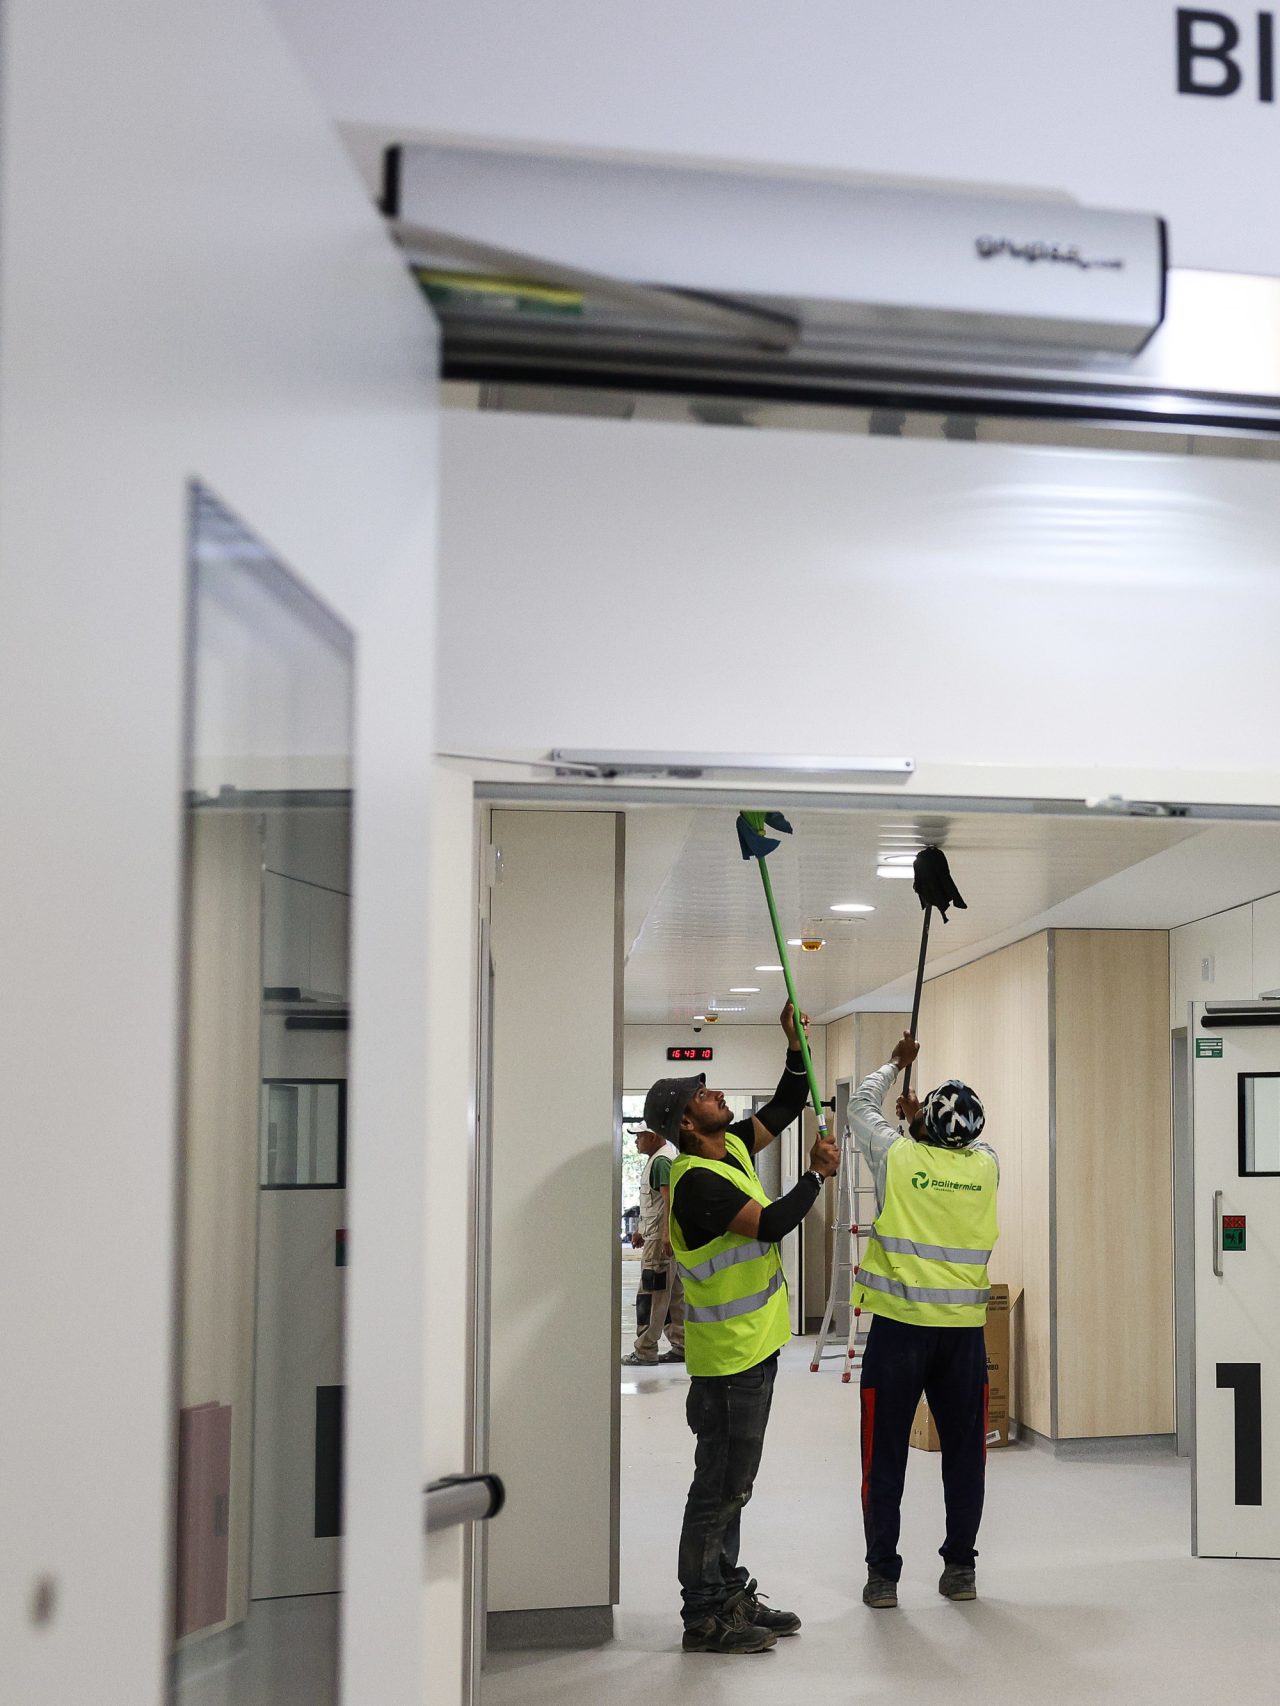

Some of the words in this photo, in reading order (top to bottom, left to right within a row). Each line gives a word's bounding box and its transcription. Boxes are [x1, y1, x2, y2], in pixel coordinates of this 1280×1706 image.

[672, 1049, 681, 1058] 16
[684, 1049, 695, 1058] 43
[701, 1049, 711, 1058] 10
[931, 1179, 982, 1192] politérmica
[1216, 1362, 1262, 1506] 1
